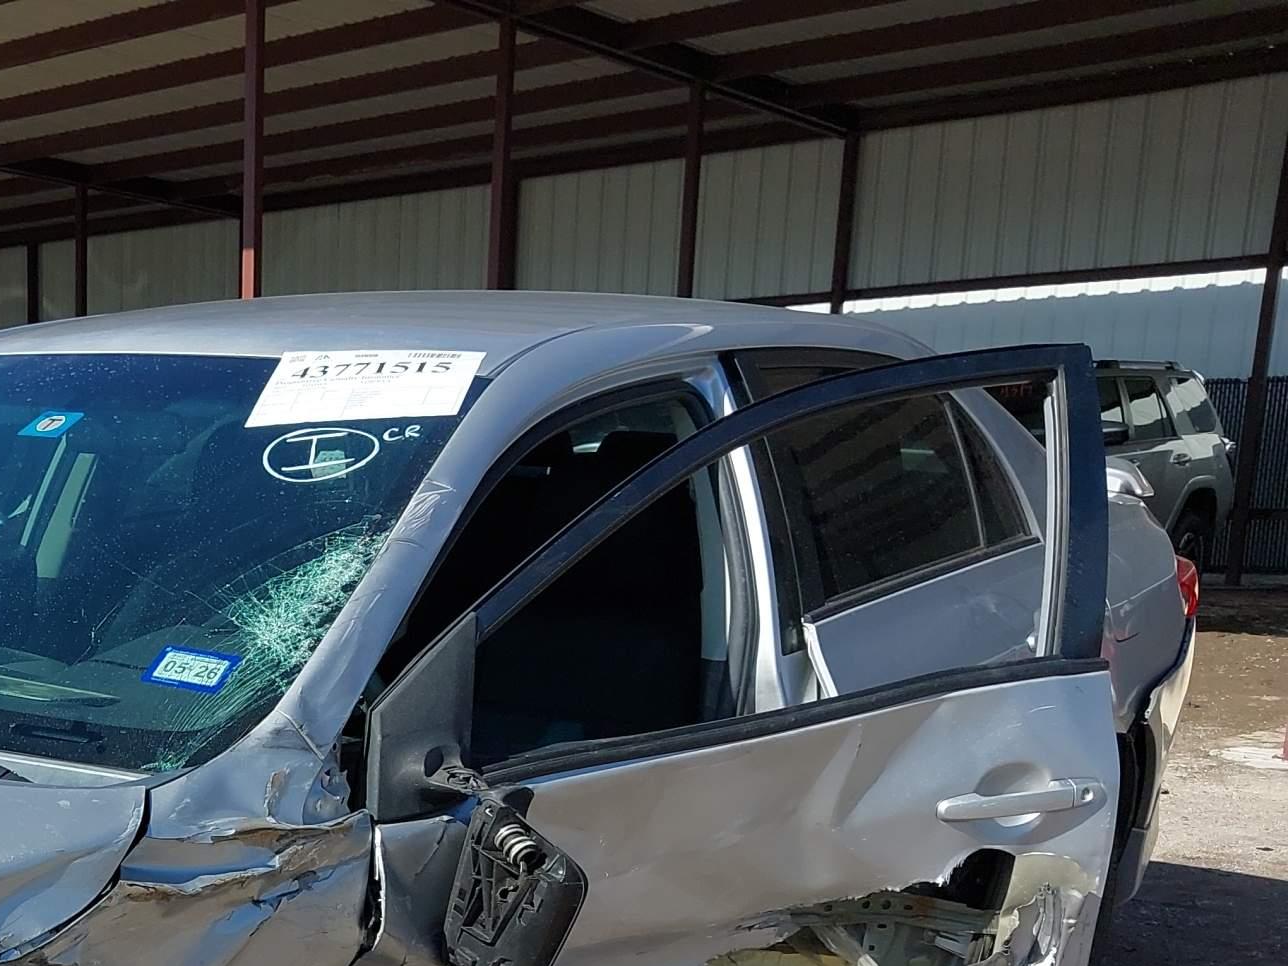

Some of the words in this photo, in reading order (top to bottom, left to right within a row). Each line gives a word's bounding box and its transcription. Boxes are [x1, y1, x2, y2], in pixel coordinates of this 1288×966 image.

[291, 361, 452, 379] 43771515
[163, 660, 190, 674] 05
[193, 665, 220, 680] 26
